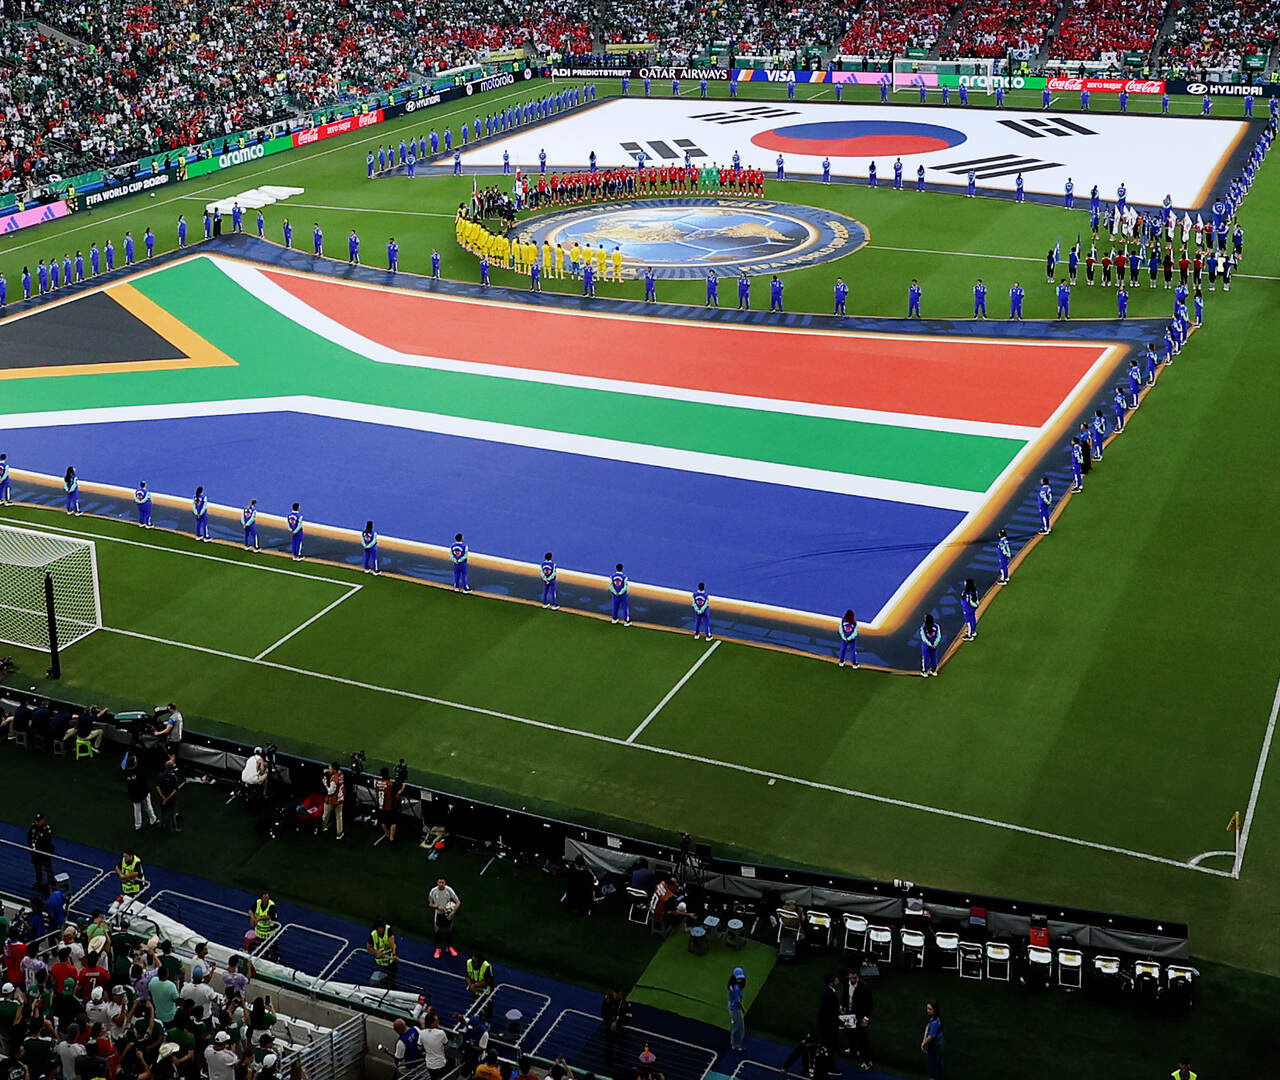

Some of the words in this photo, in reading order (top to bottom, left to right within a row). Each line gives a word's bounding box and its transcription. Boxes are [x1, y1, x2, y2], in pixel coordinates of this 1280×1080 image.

[552, 68, 571, 77] ADI
[639, 67, 676, 79] QATAR
[681, 68, 728, 80] AIRWAYS
[764, 70, 796, 82] VISA
[480, 70, 515, 92] motorola
[958, 75, 1026, 89] aramco
[1047, 77, 1083, 92] Coca-Cola
[1103, 82, 1123, 90] sugar
[1125, 80, 1161, 93] Coca-Cola
[1210, 85, 1263, 96] HYUNDAI
[415, 94, 441, 109] HYUNDAI
[218, 143, 265, 169] aramco
[86, 193, 103, 206] FIFA
[103, 186, 129, 201] WORLD
[129, 182, 144, 194] CUP
